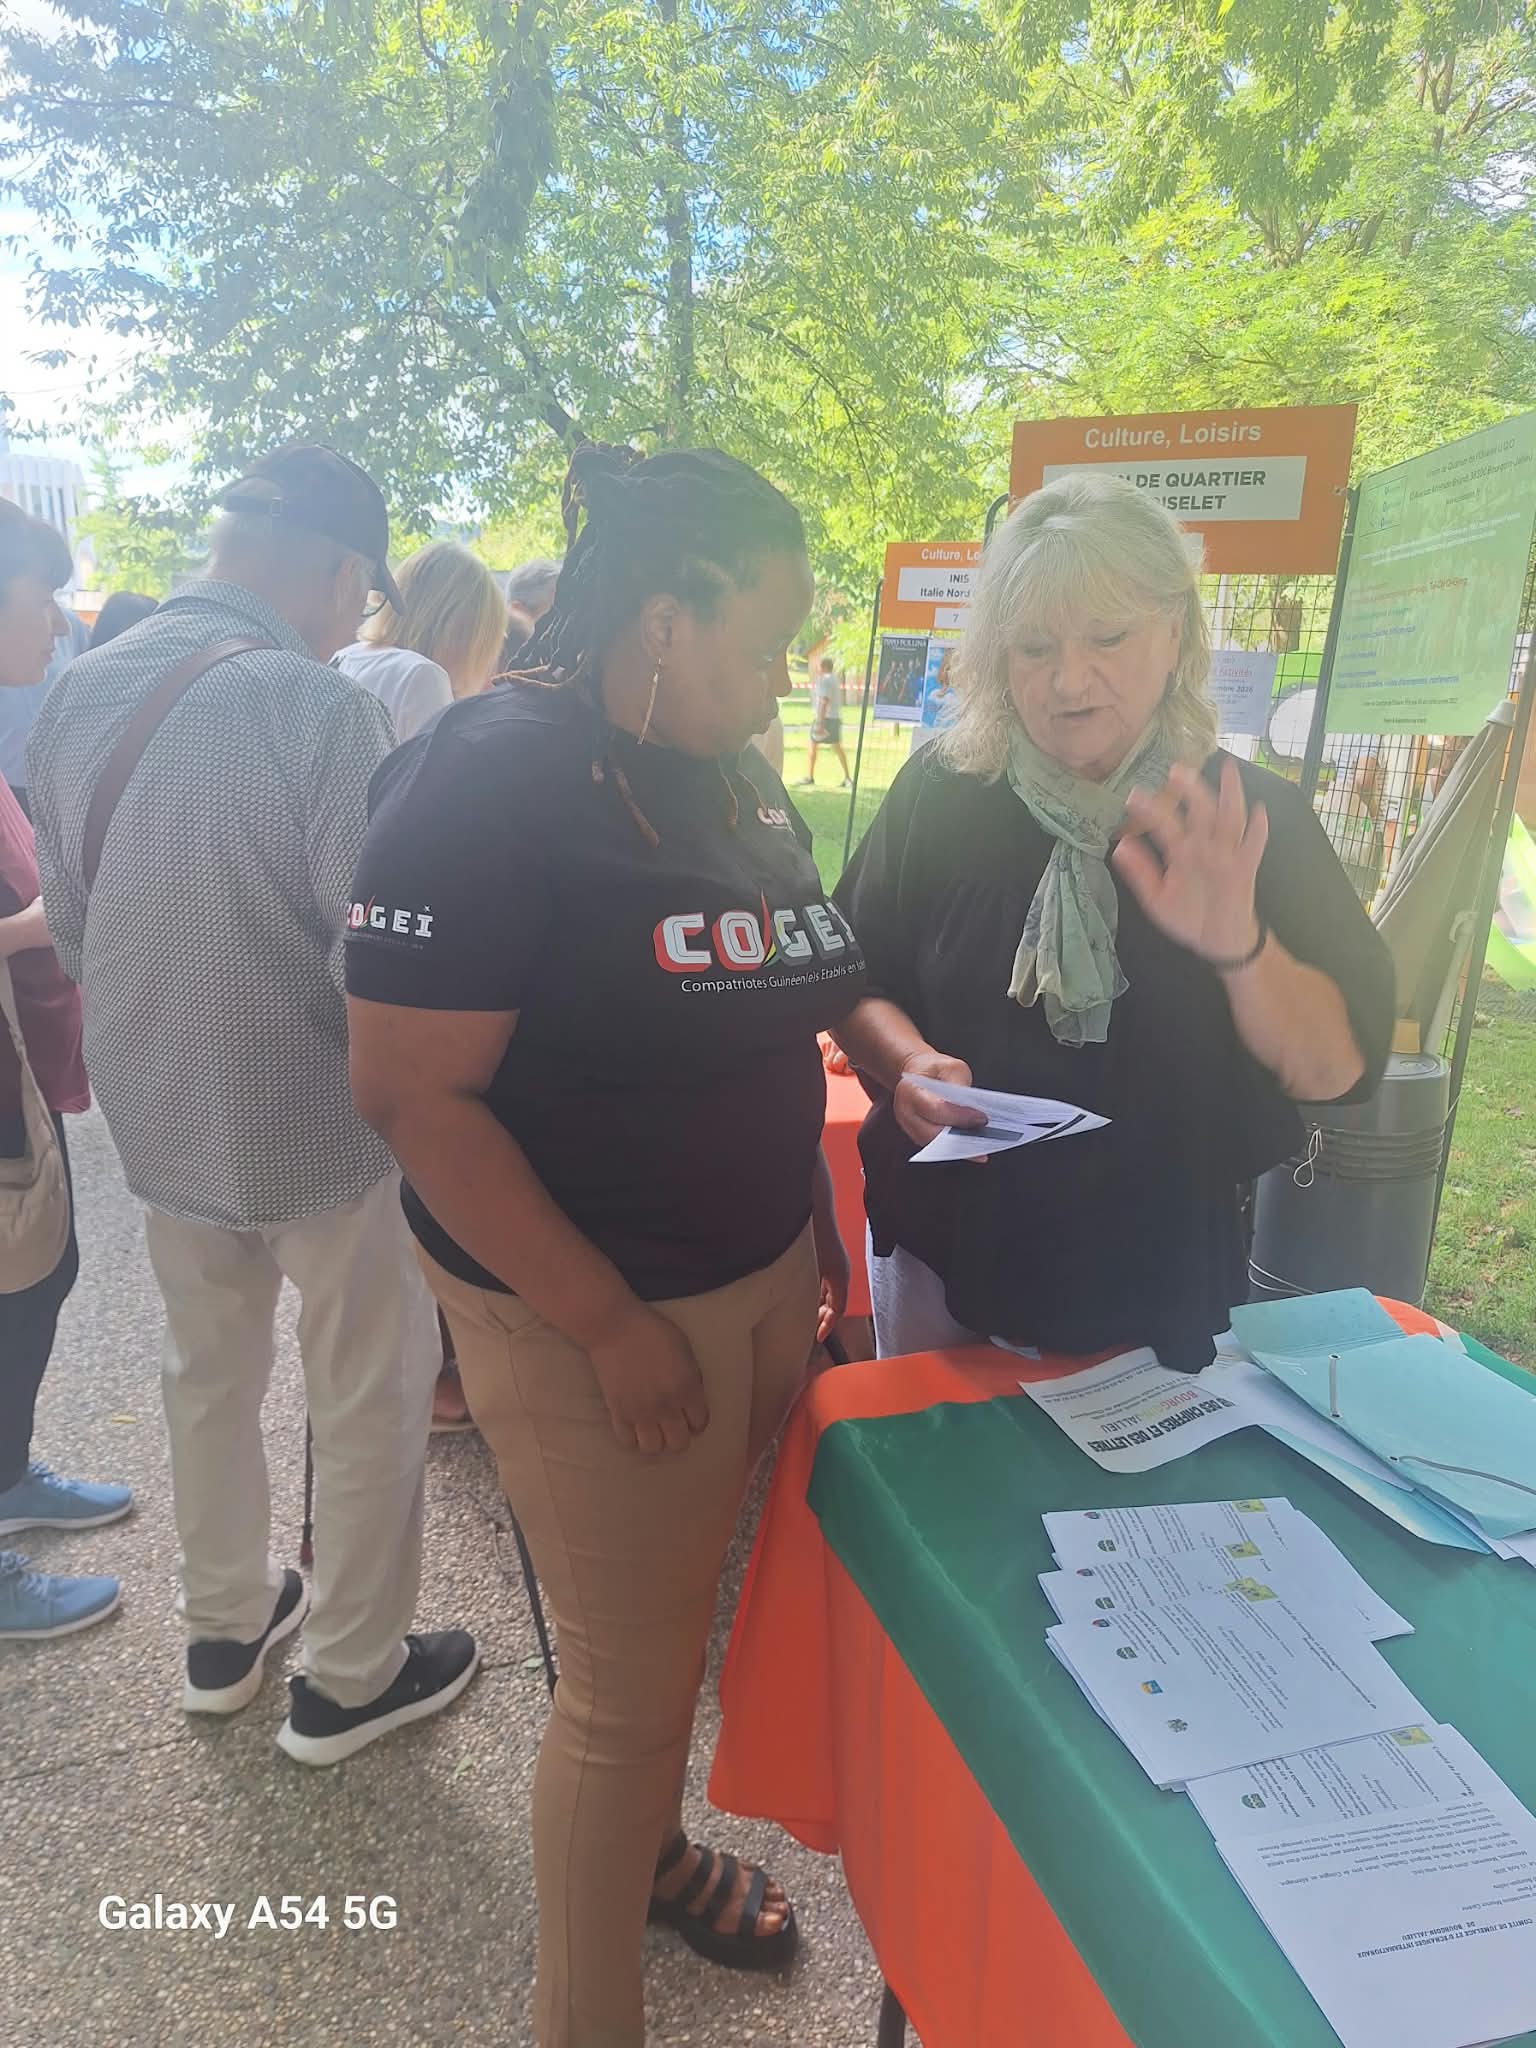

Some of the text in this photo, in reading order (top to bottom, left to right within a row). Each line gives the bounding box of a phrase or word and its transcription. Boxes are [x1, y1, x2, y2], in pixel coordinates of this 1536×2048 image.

[1084, 423, 1262, 448] Culture, Loisirs
[1136, 473, 1161, 488] DE
[1166, 470, 1266, 488] QUARTIER
[921, 548, 981, 562] Culture, Lo
[950, 573, 969, 584] INIS
[920, 587, 971, 598] Italie Nord
[952, 613, 960, 623] 7
[680, 974, 769, 994] Compatriotes
[820, 964, 847, 981] Etablis
[1200, 1397, 1220, 1414] DES
[1158, 1405, 1204, 1431] CHIFFRES
[1126, 1430, 1149, 1446] DES
[1147, 1424, 1163, 1440] ET
[1087, 1436, 1128, 1453] LETTRES
[1401, 1924, 1463, 1941] BOURGOIN-JALLIEU
[1357, 1941, 1414, 1958] INTERNATIONAUX
